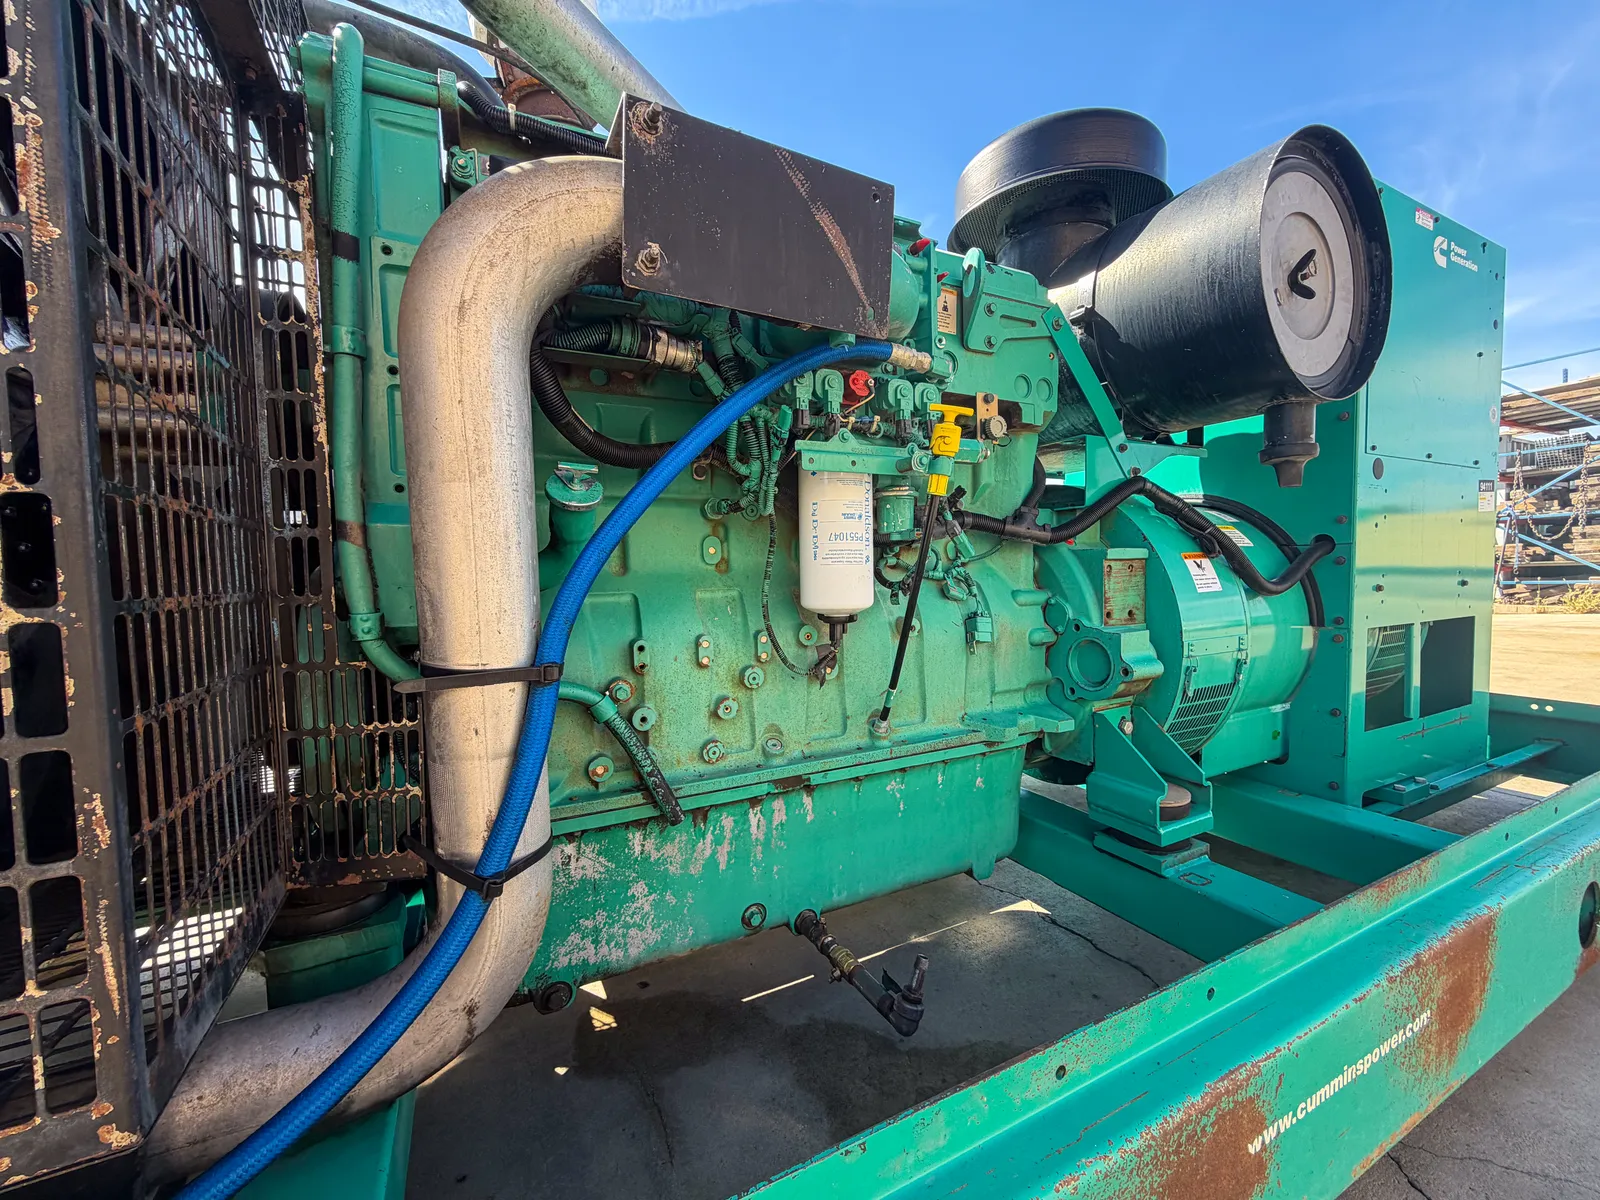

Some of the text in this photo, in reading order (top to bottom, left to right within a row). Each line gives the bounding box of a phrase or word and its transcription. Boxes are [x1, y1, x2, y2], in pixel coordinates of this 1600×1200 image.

[1450, 241, 1467, 257] Power
[1450, 251, 1478, 273] Generation
[828, 531, 864, 542] P551047
[1247, 1009, 1432, 1155] www.cumminspower.com
